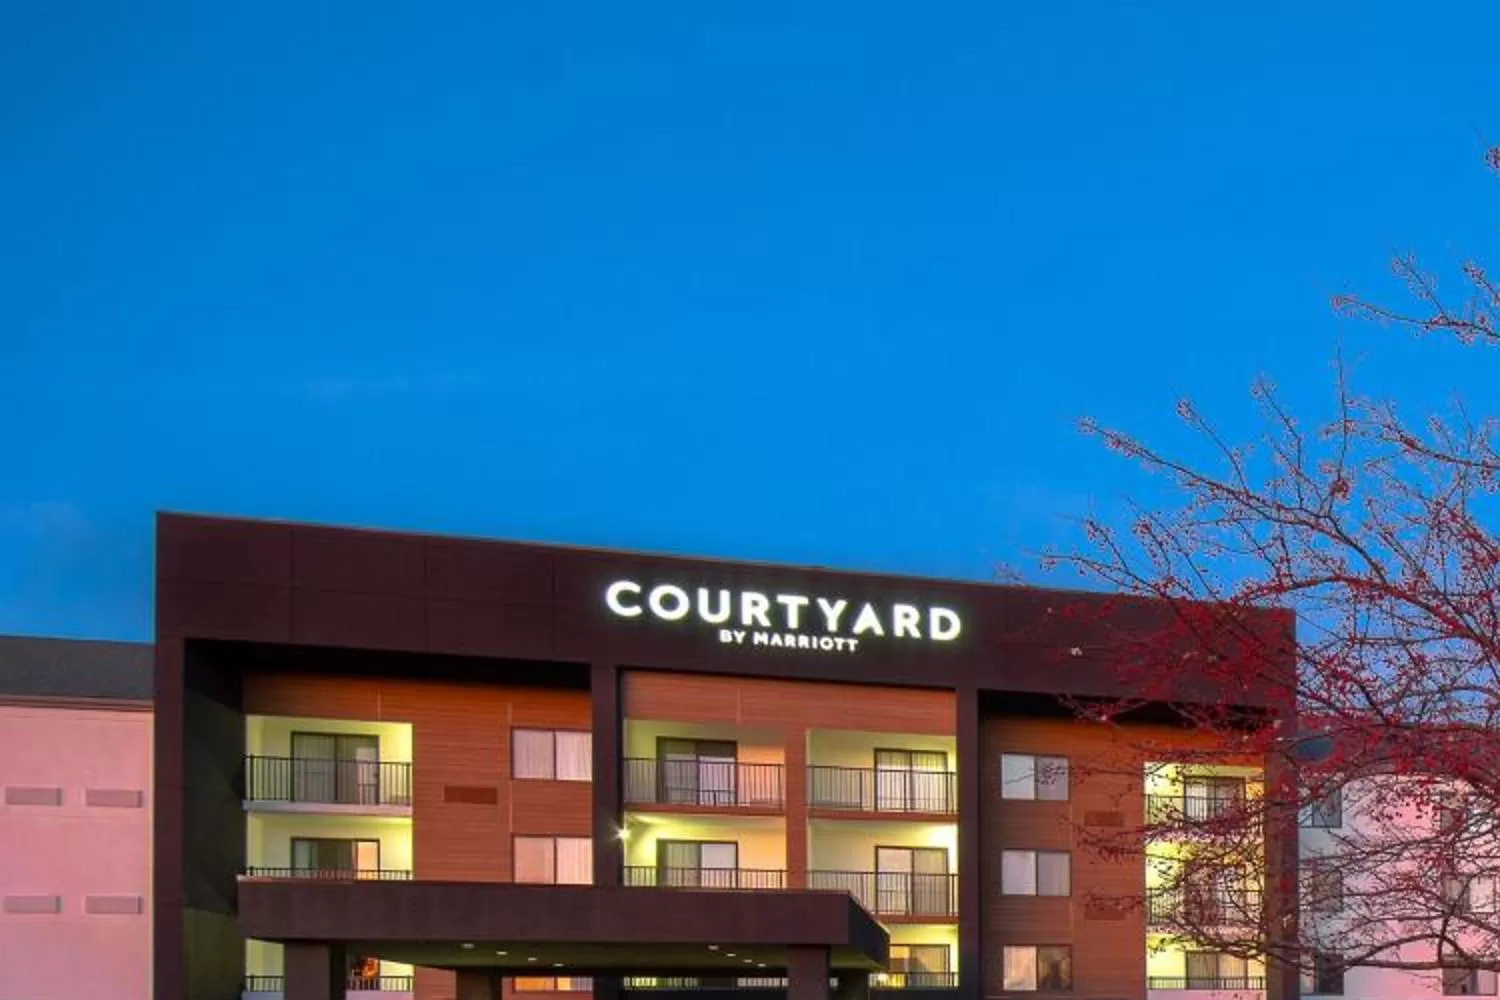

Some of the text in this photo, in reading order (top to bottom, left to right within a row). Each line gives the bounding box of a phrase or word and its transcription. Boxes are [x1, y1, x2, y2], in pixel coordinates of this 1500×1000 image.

[604, 579, 962, 642] COURTYARD
[718, 629, 859, 652] BY MARRIOTT
